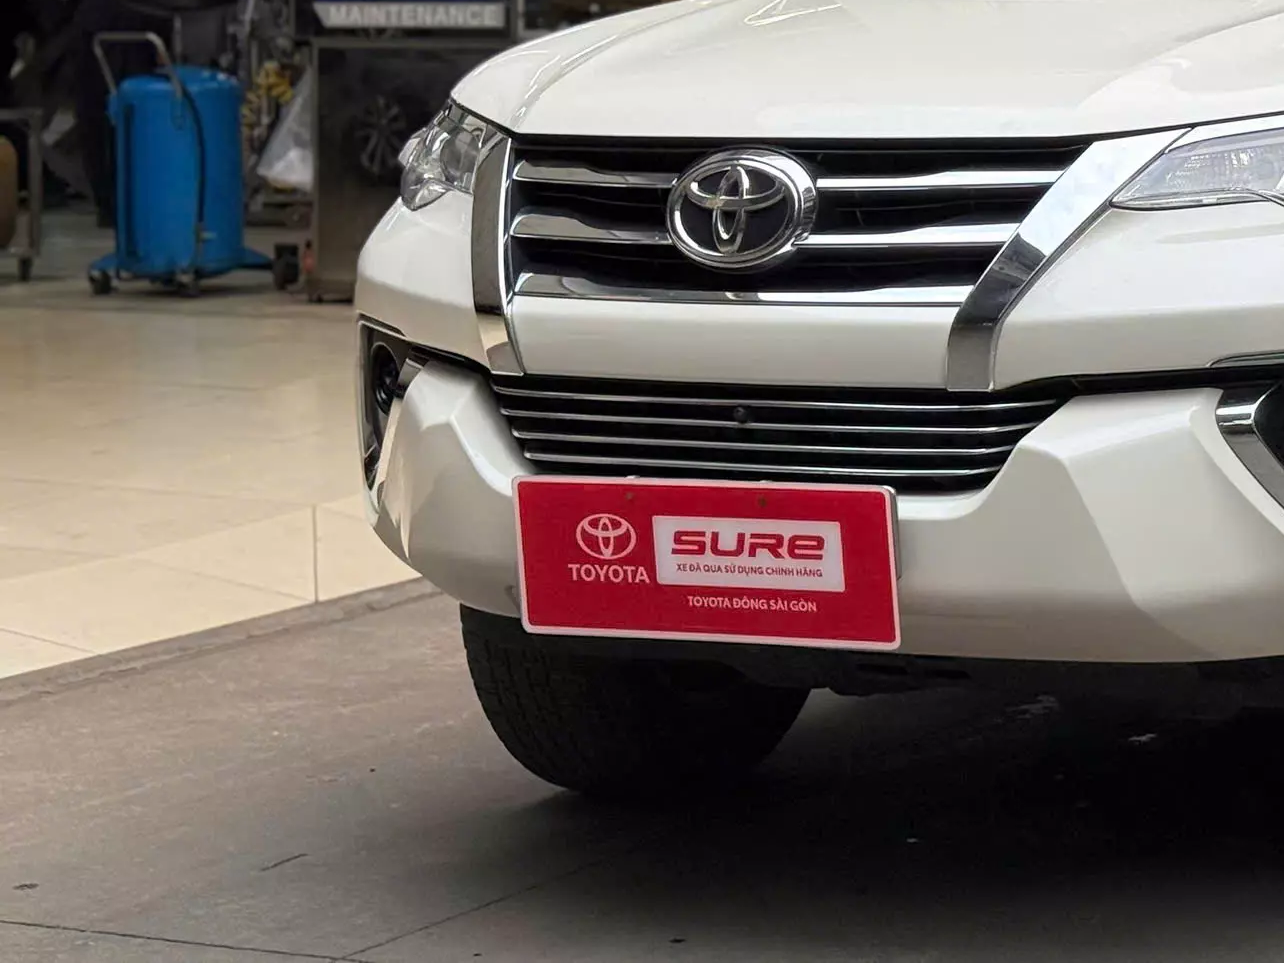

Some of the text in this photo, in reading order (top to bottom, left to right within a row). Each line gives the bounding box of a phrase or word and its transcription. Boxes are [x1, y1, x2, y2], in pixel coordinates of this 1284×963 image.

[328, 3, 499, 27] MAINTENANCE
[567, 564, 650, 584] TOYOTA
[676, 563, 688, 572] XE
[703, 564, 723, 574] QUA
[738, 565, 764, 577] DỤNG
[687, 595, 817, 612] TOYOTA ĐÔNG SÀI GÒN
